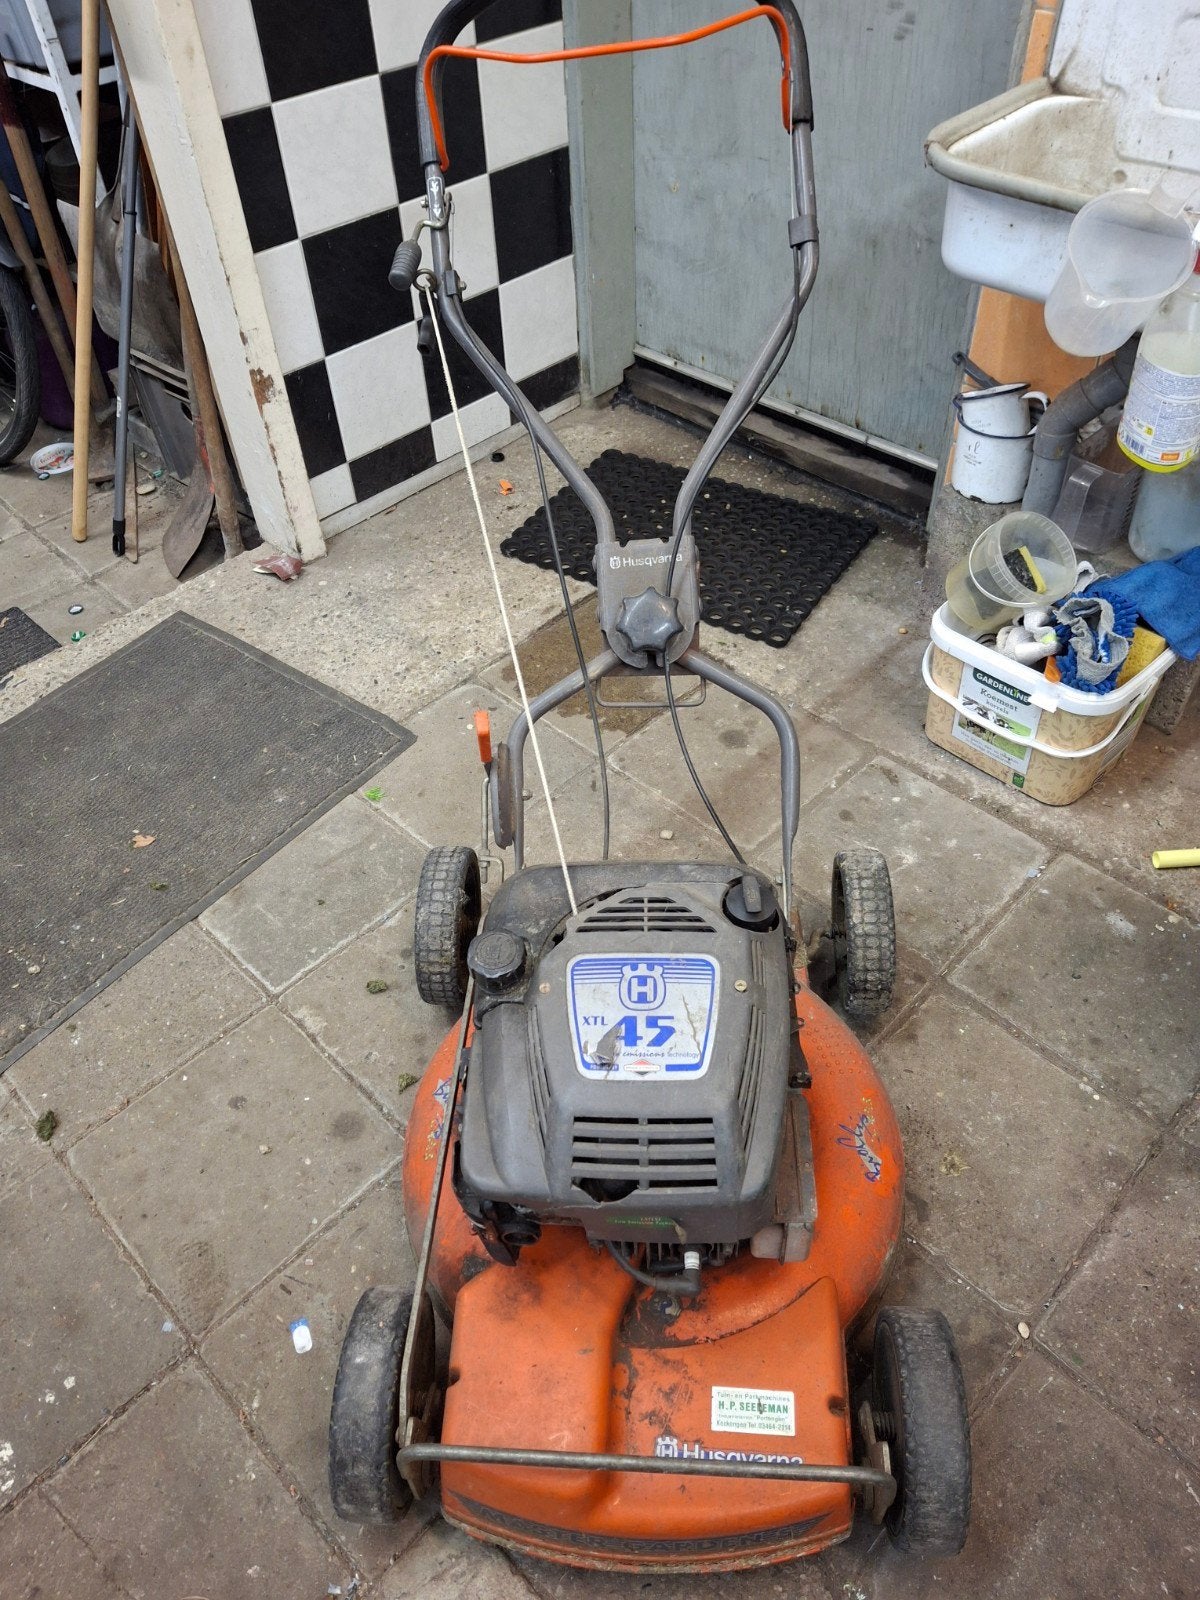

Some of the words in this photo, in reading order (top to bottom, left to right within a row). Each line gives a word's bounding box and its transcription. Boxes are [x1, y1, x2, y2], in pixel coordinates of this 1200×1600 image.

[622, 553, 683, 568] Husqvara
[976, 672, 1029, 703] GARDENLINE
[980, 688, 1018, 712] Koemest
[582, 1016, 608, 1026] XTL
[612, 1015, 676, 1047] 45
[622, 1047, 665, 1058] emissions
